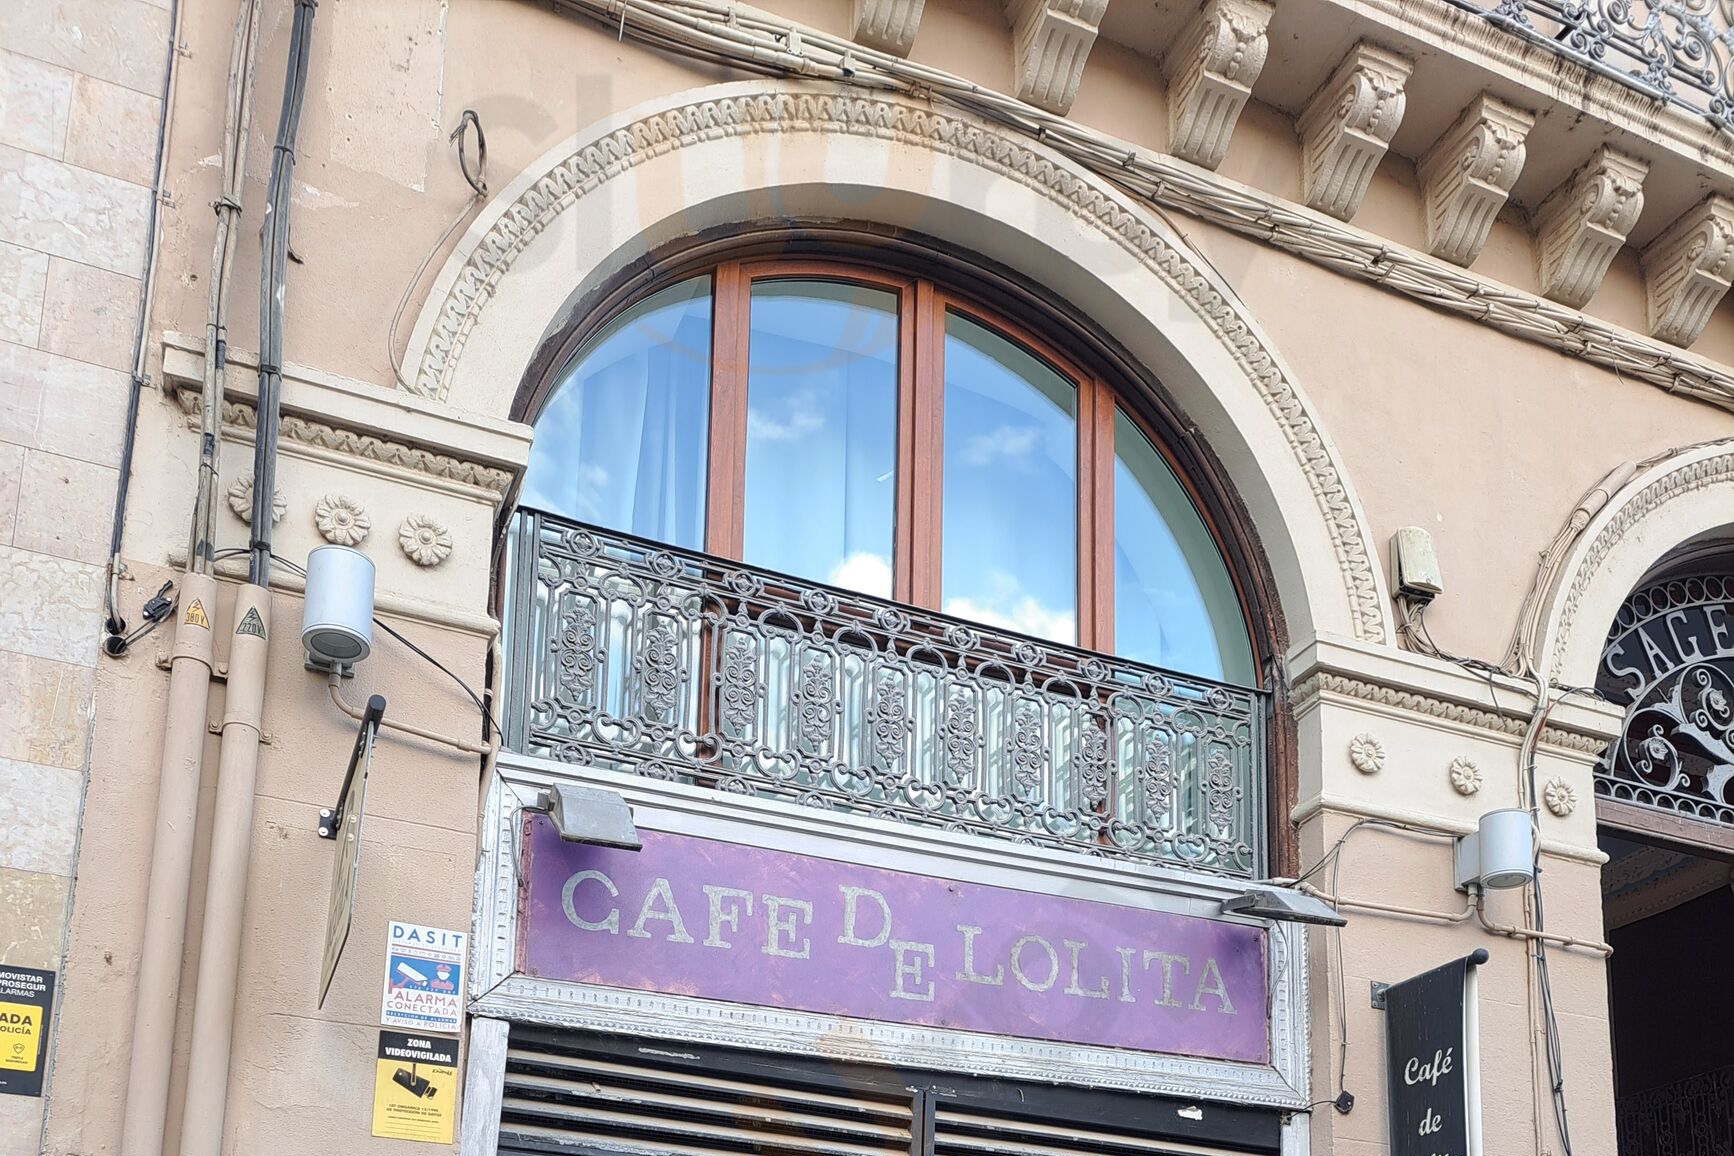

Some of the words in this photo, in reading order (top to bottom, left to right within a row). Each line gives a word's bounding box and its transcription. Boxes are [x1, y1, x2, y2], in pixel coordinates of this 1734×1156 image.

[393, 925, 462, 948] DASIT
[560, 869, 812, 960] CAFE
[955, 923, 1238, 1015] LOLITA
[0, 987, 35, 998] LARMAS
[394, 990, 457, 1007] ALARMA
[386, 1000, 458, 1017] CONECTADA
[407, 1038, 431, 1049] ZONA
[385, 1047, 452, 1063] VIDEOVIGILADA
[1403, 1047, 1453, 1087] Café
[1418, 1106, 1443, 1137] de
